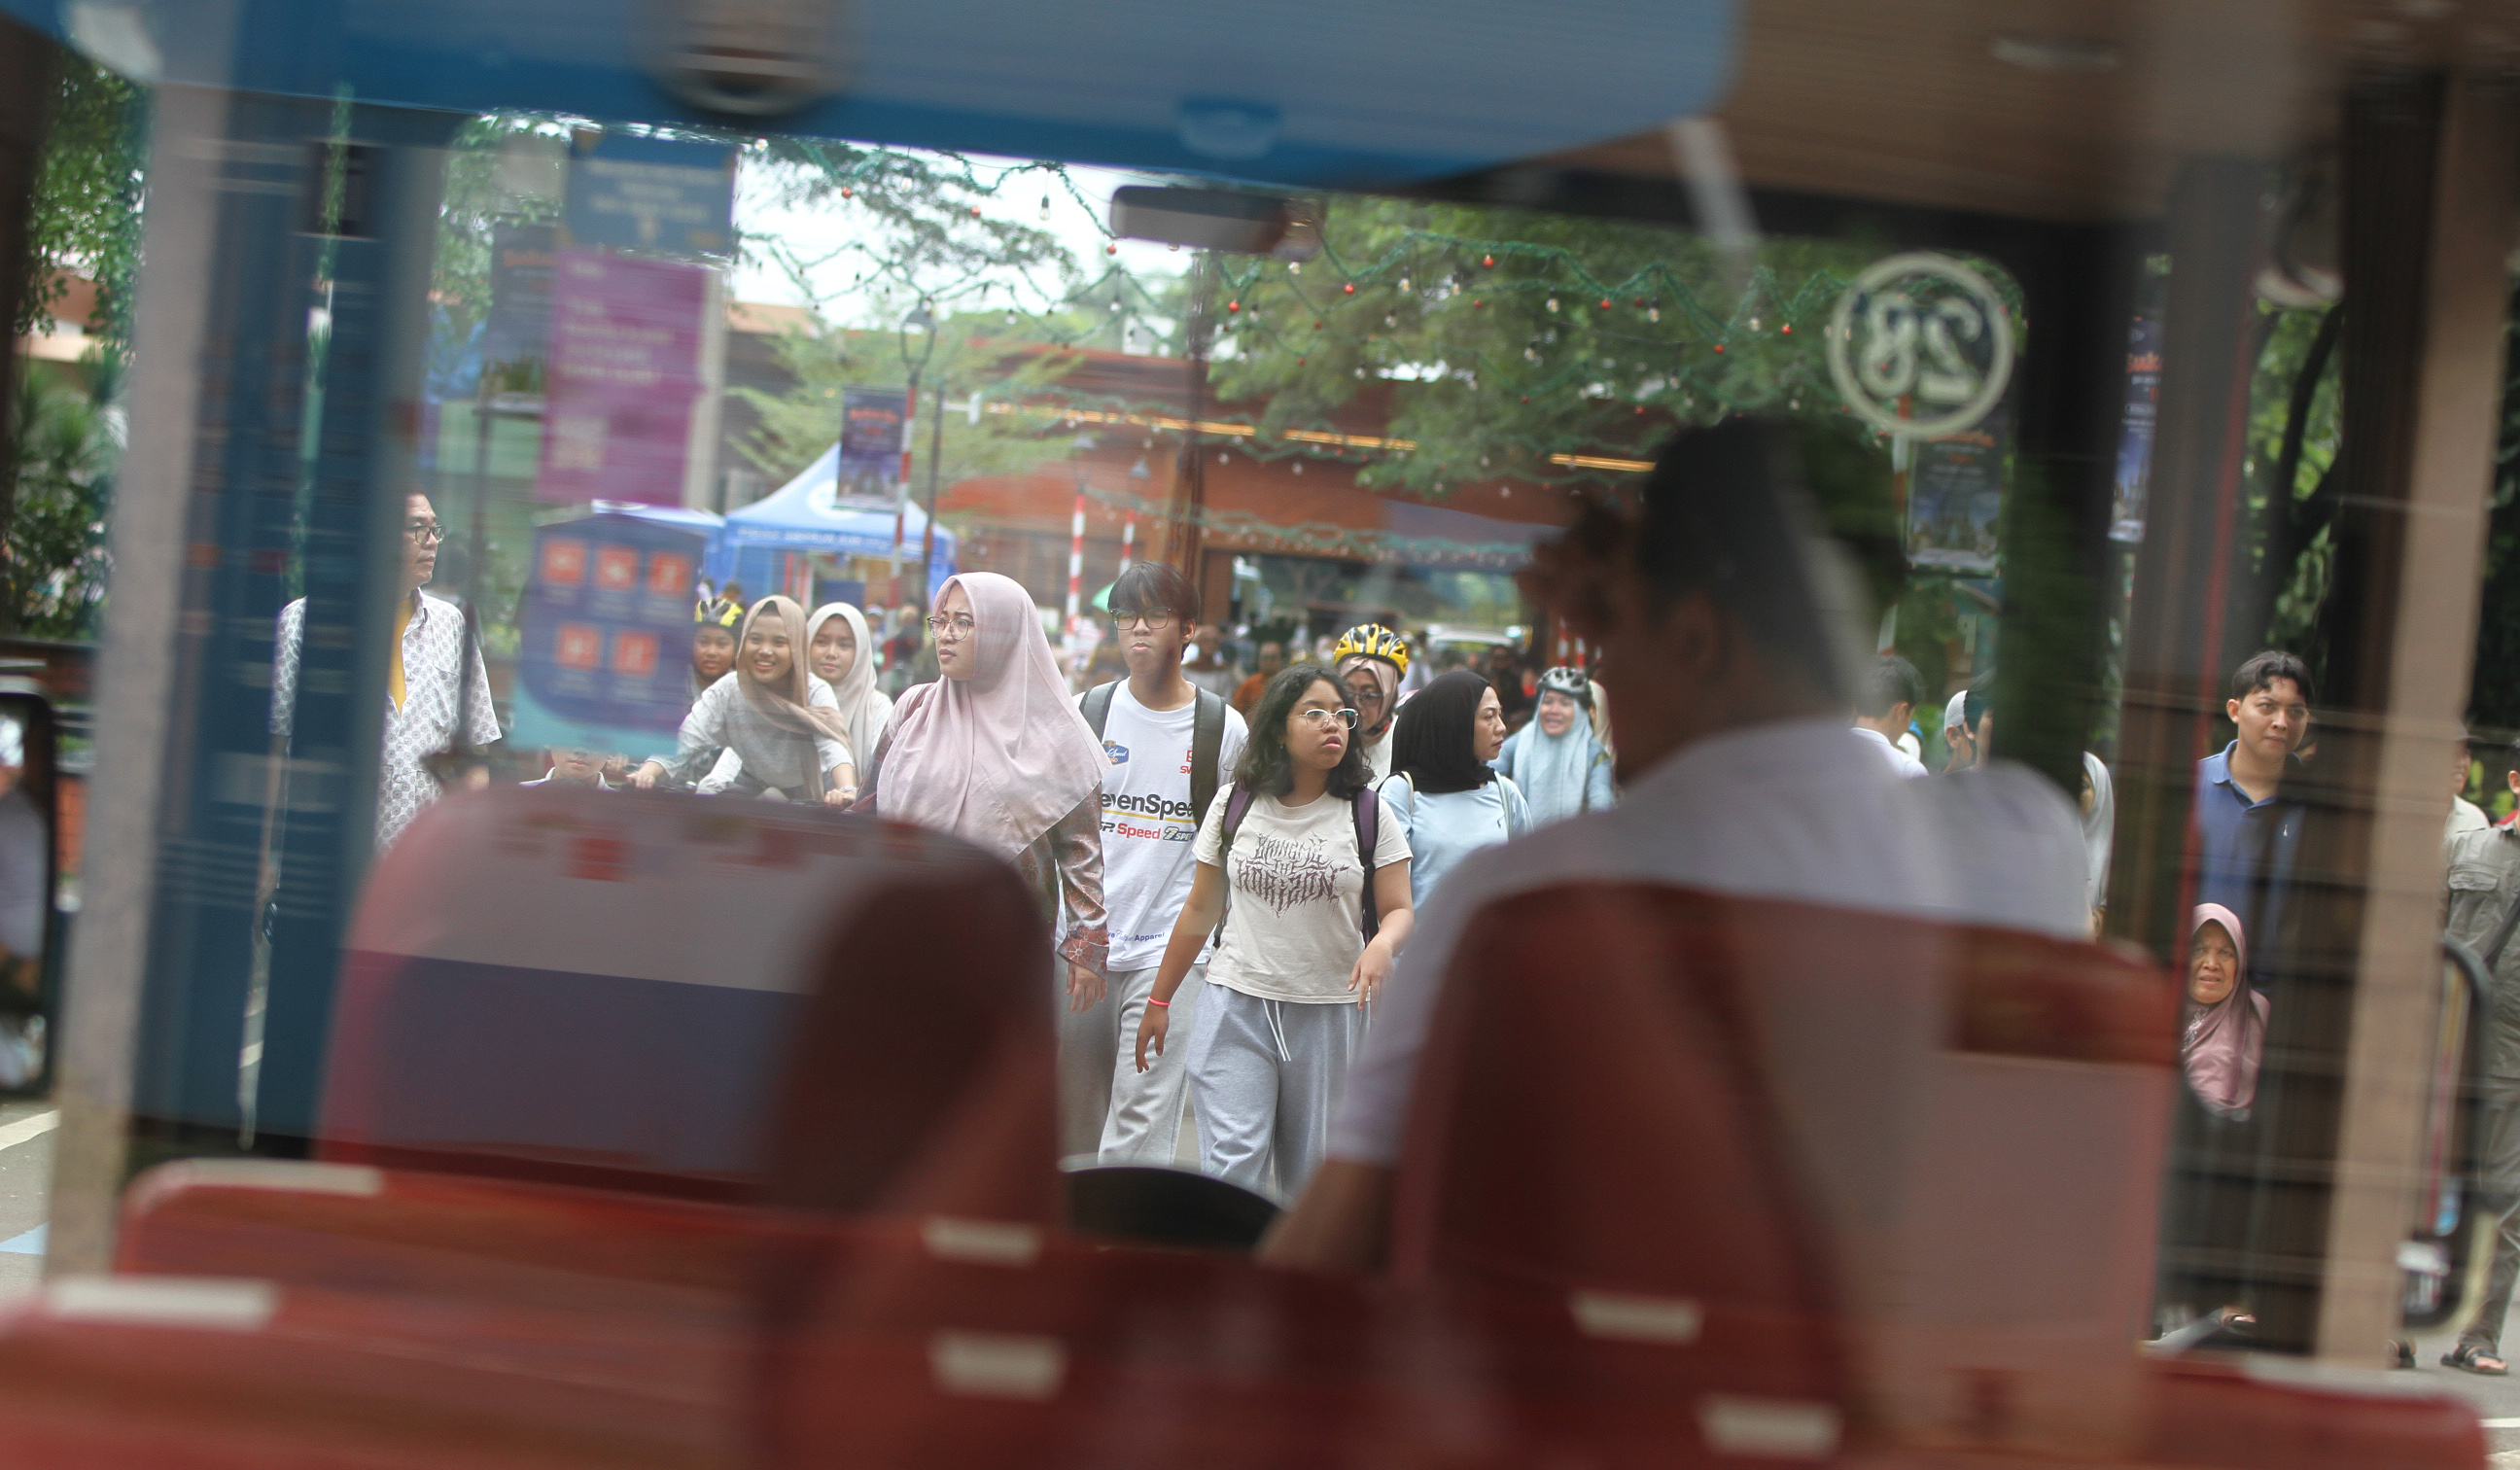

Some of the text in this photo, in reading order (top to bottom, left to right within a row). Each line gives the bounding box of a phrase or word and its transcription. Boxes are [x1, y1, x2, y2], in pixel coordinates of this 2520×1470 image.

[1117, 822, 1162, 839] Speed
[1235, 858, 1349, 912] HORIZON
[1135, 931, 1165, 942] Apparel
